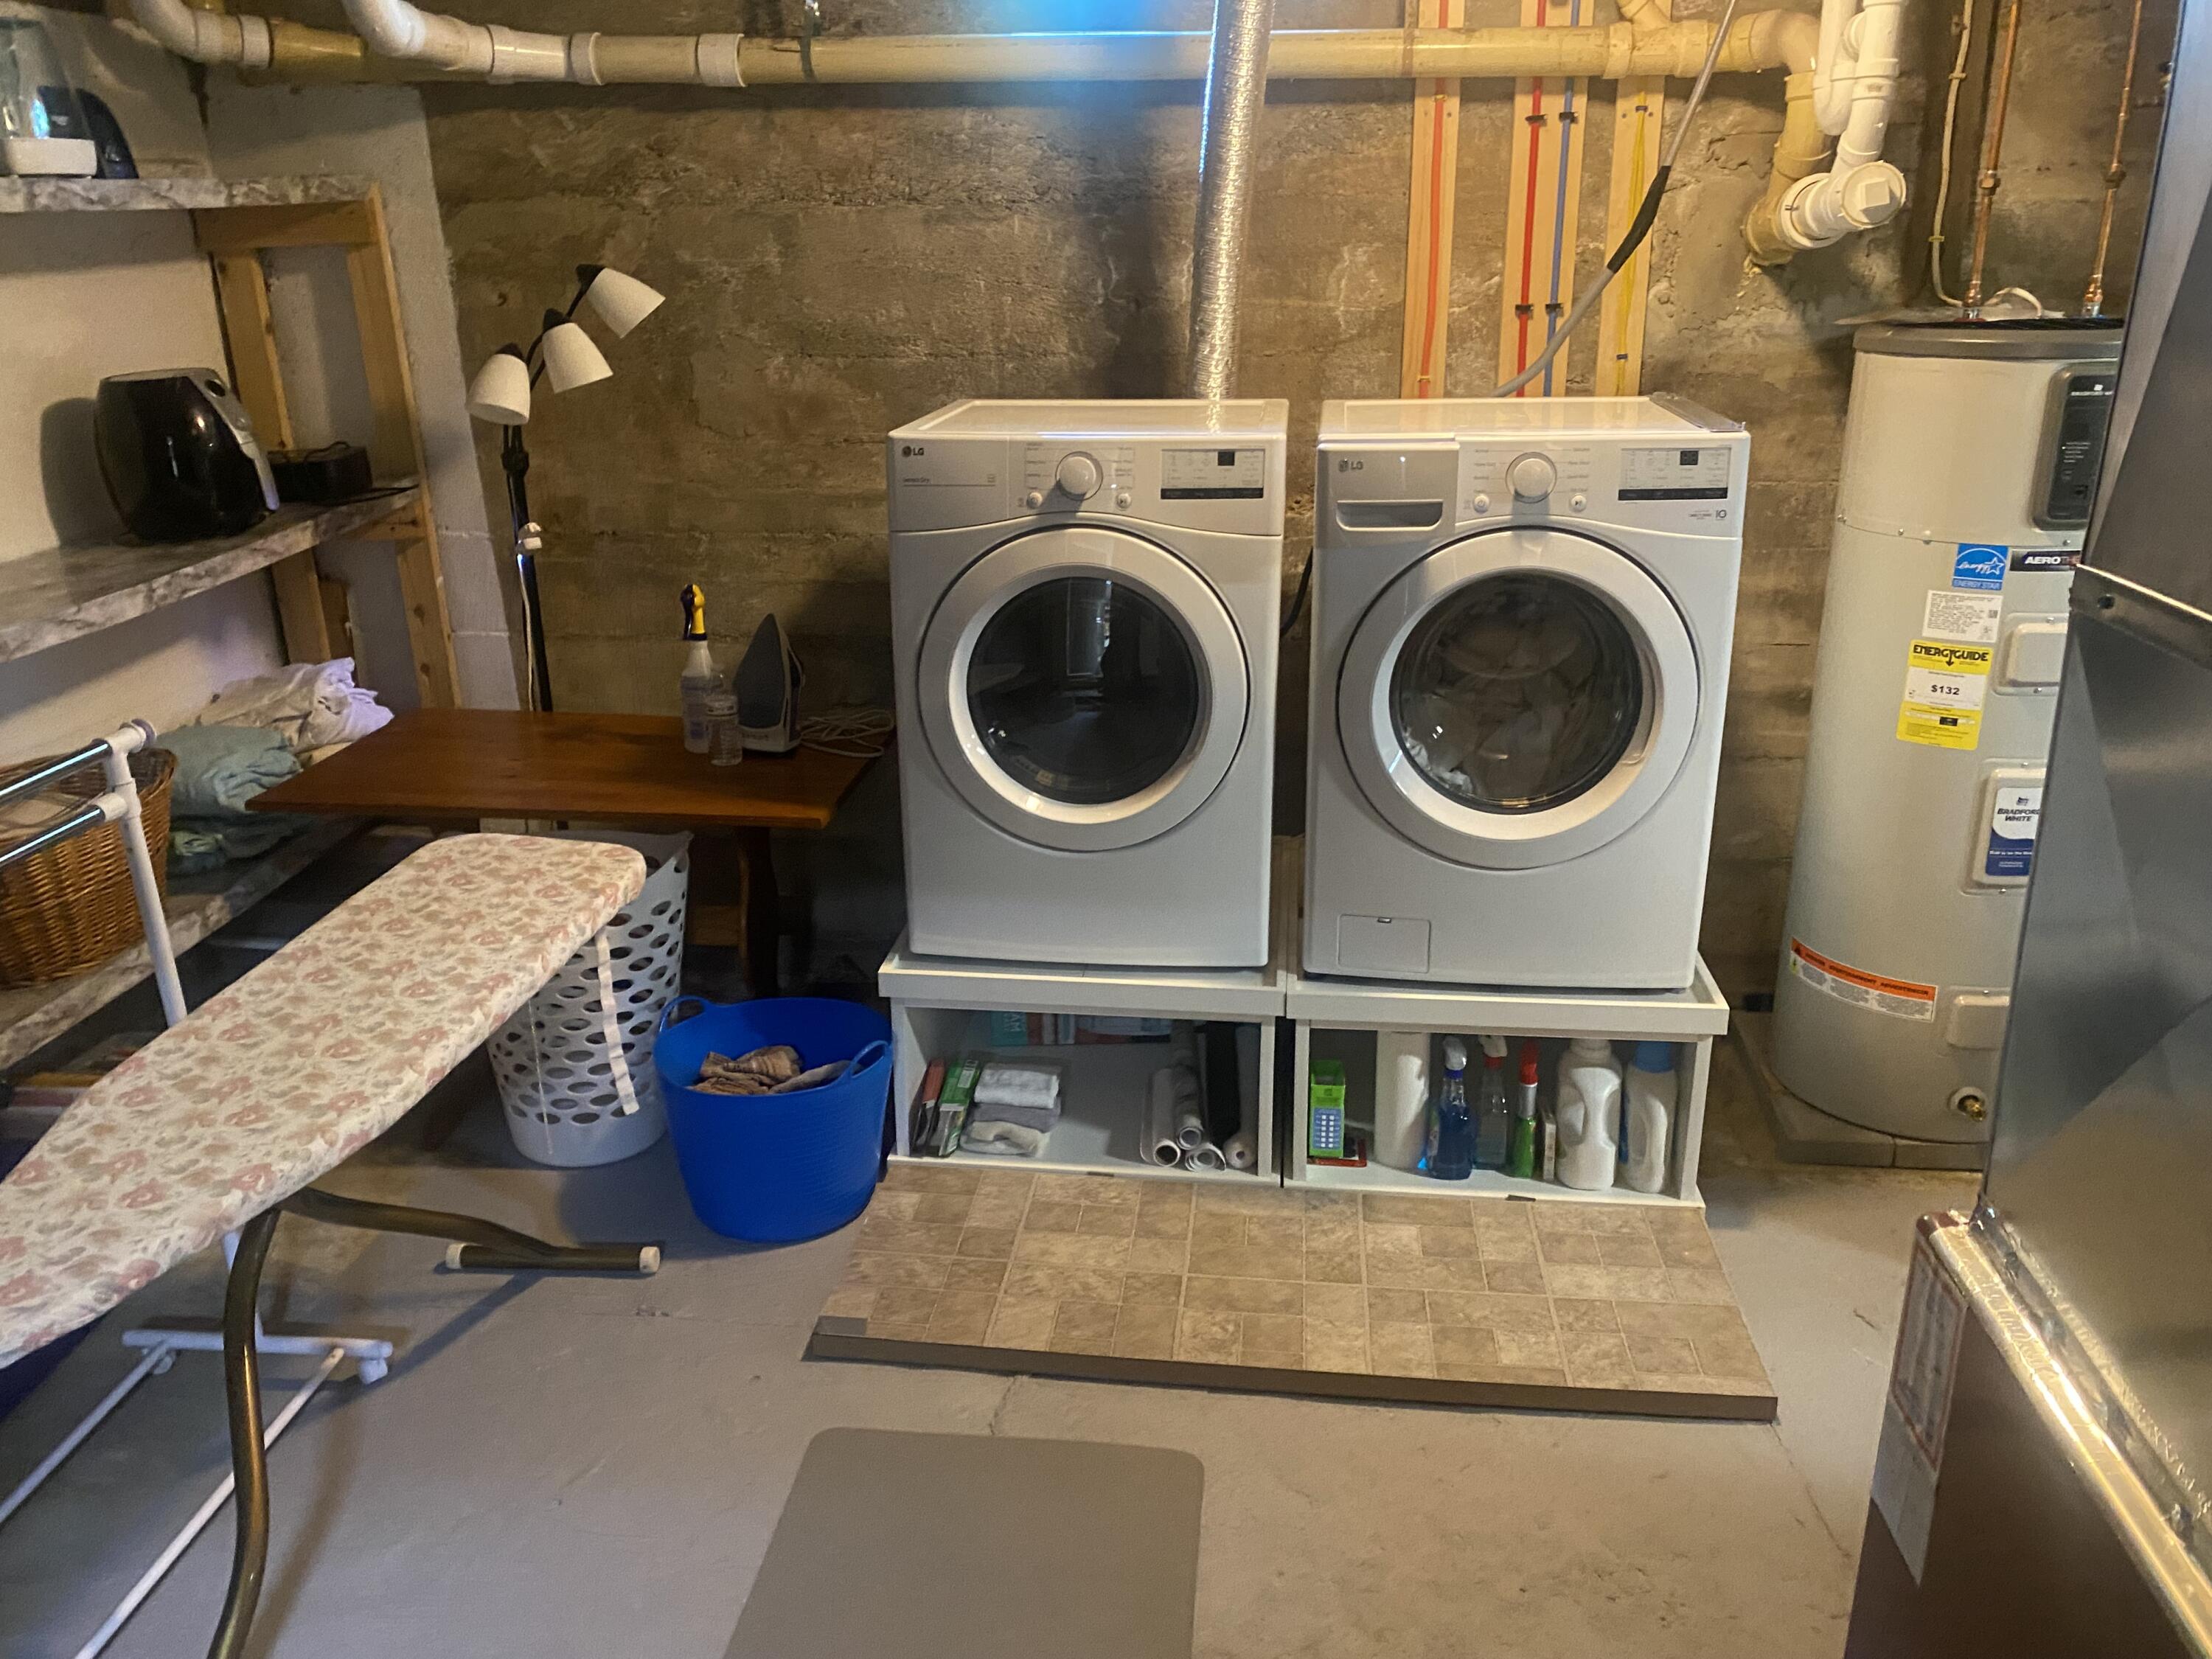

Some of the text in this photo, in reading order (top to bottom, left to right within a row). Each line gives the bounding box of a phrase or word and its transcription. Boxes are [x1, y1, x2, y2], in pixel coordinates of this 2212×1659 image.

[912, 447, 925, 456] LG
[1351, 460, 1363, 470] LG
[1931, 684, 1960, 695] $132
